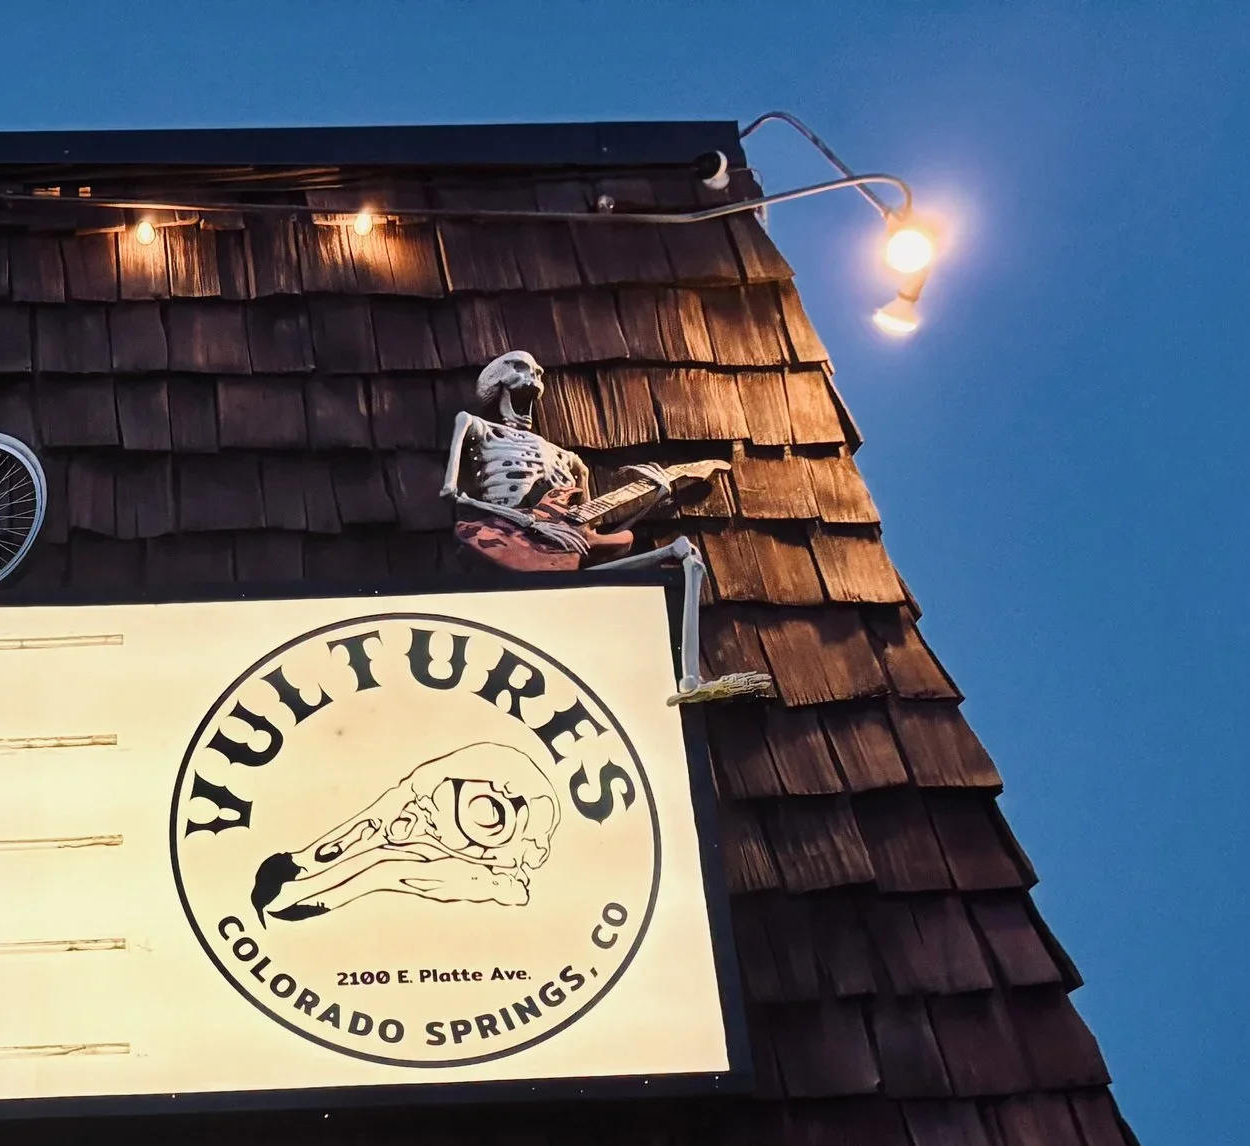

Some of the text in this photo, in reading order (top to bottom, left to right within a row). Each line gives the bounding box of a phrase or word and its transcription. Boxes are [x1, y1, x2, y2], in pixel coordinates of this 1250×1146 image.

[184, 627, 636, 839] VULTURES
[217, 901, 628, 1046] COLORADO SPRINGS, CO
[337, 967, 531, 985] 2100 E. Platte Ave.
